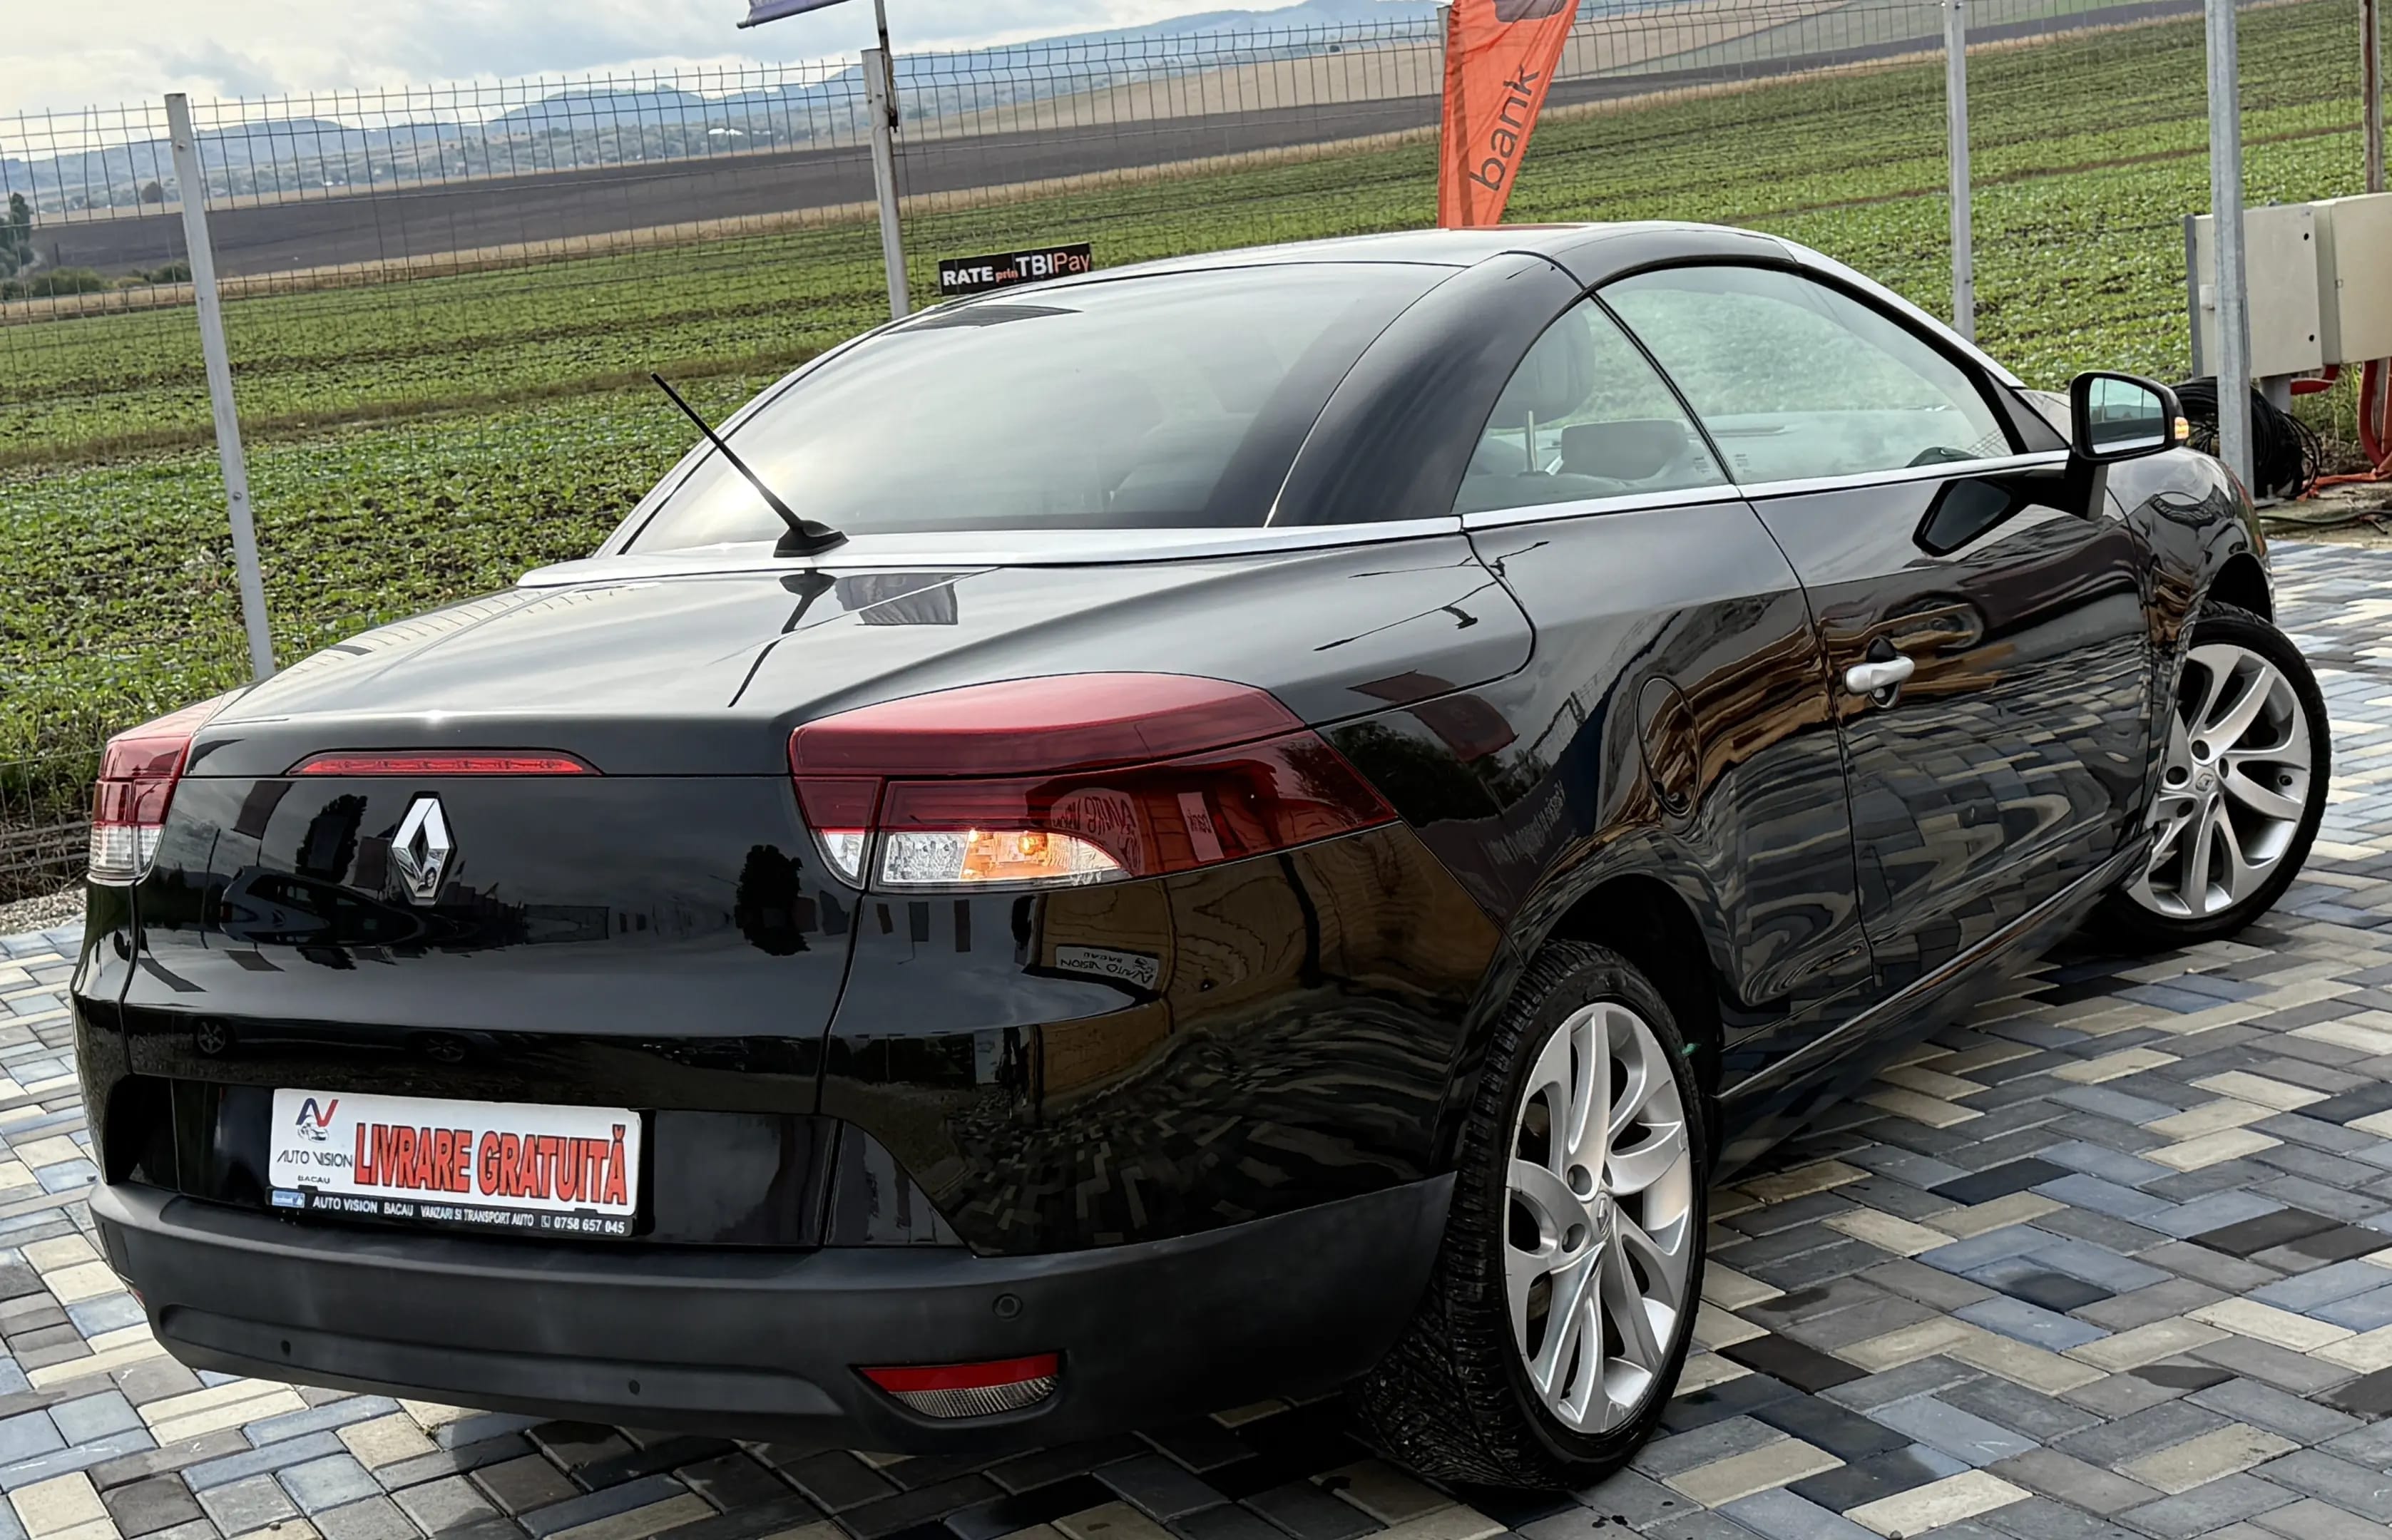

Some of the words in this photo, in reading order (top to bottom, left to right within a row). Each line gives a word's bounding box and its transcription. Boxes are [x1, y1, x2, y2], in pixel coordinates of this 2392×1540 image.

[1469, 63, 1540, 192] bank
[942, 266, 994, 286] RATE
[995, 268, 1019, 284] prin
[1016, 252, 1090, 277] TBIPay
[277, 1150, 310, 1164] AUTO
[312, 1151, 354, 1168] VISION
[354, 1123, 473, 1194] LIVRARE
[477, 1124, 628, 1206] GRATUITĂ
[297, 1175, 331, 1184] BACAU
[312, 1196, 341, 1210] AUTO
[343, 1198, 378, 1213] VISION
[384, 1202, 414, 1216] BACAU
[464, 1208, 511, 1224] TRANSPORT
[511, 1213, 534, 1227] AUTO
[553, 1216, 579, 1230] 0758
[582, 1218, 602, 1232] 657
[605, 1221, 625, 1234] 045
